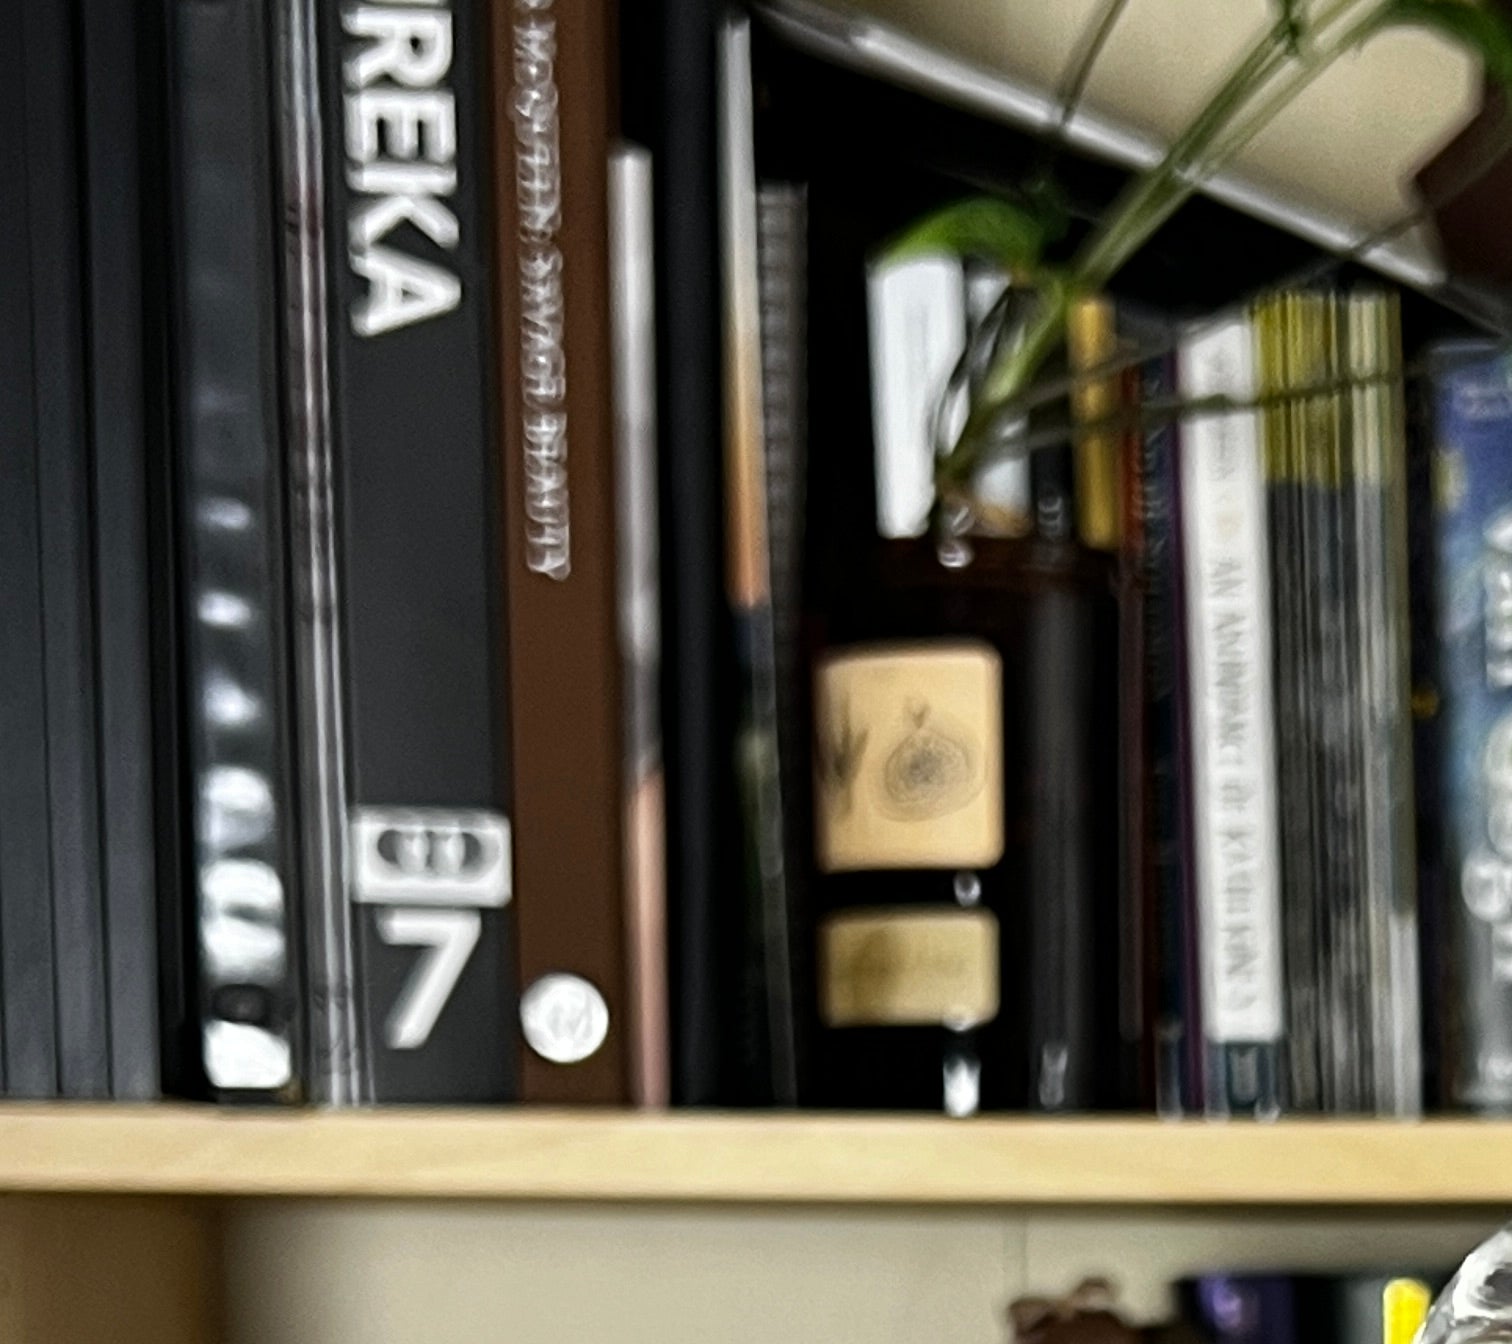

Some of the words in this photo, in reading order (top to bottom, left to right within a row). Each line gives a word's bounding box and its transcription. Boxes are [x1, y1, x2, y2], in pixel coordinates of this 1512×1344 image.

[338, 0, 461, 338] REKA
[519, 246, 566, 403] SAVAGE
[524, 411, 572, 580] BEAUTY
[376, 908, 482, 1050] 7
